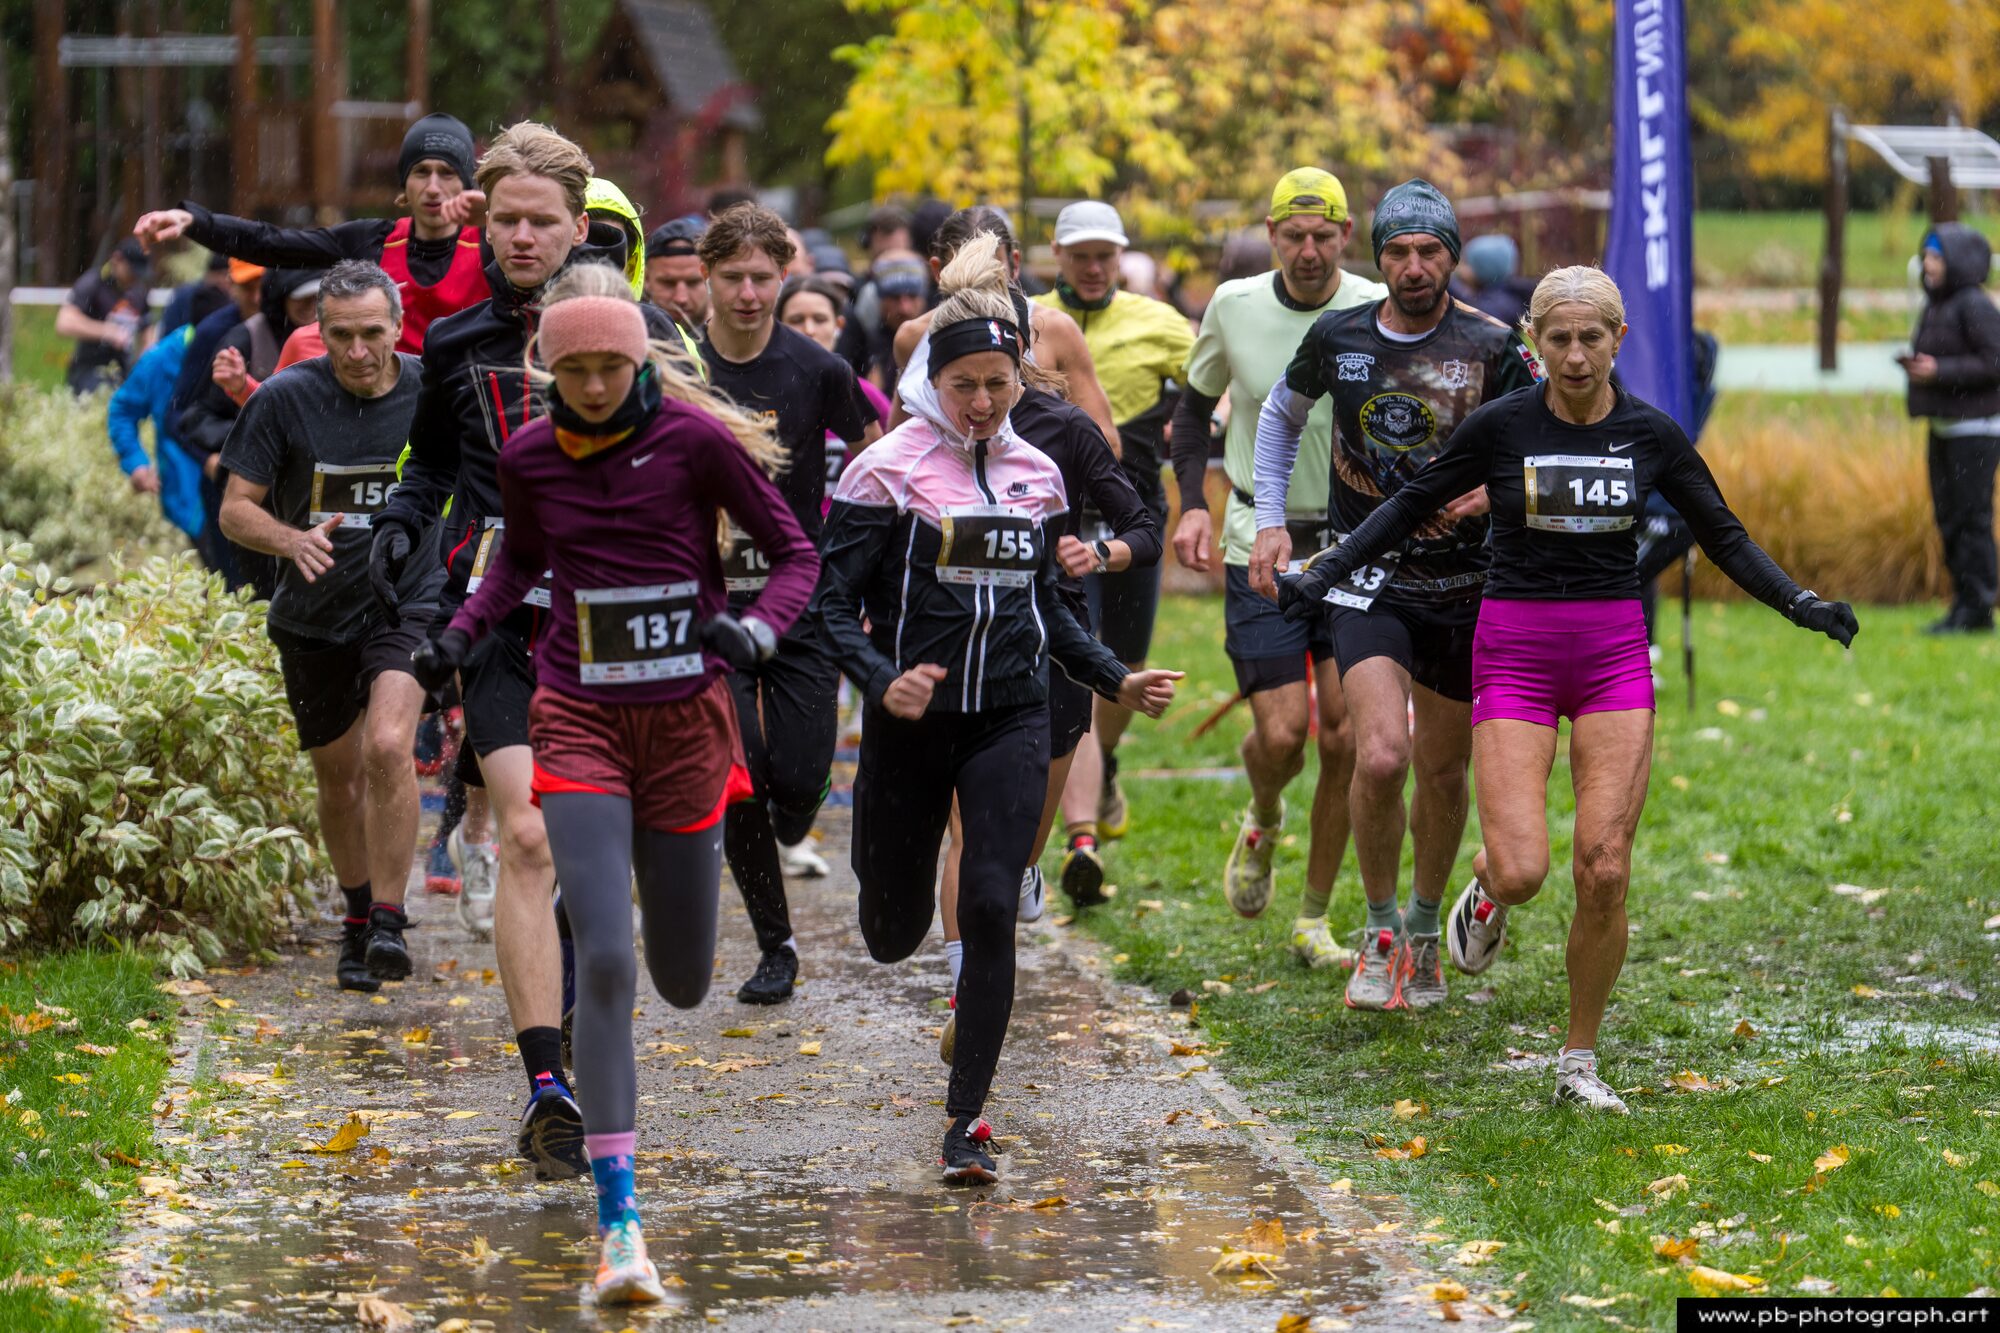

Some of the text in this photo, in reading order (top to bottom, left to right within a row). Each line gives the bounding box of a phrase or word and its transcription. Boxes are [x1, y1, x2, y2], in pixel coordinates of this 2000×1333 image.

[1010, 481, 1029, 495] NIKE
[1568, 478, 1629, 507] 145
[983, 529, 1035, 561] 155
[626, 609, 692, 650] 137
